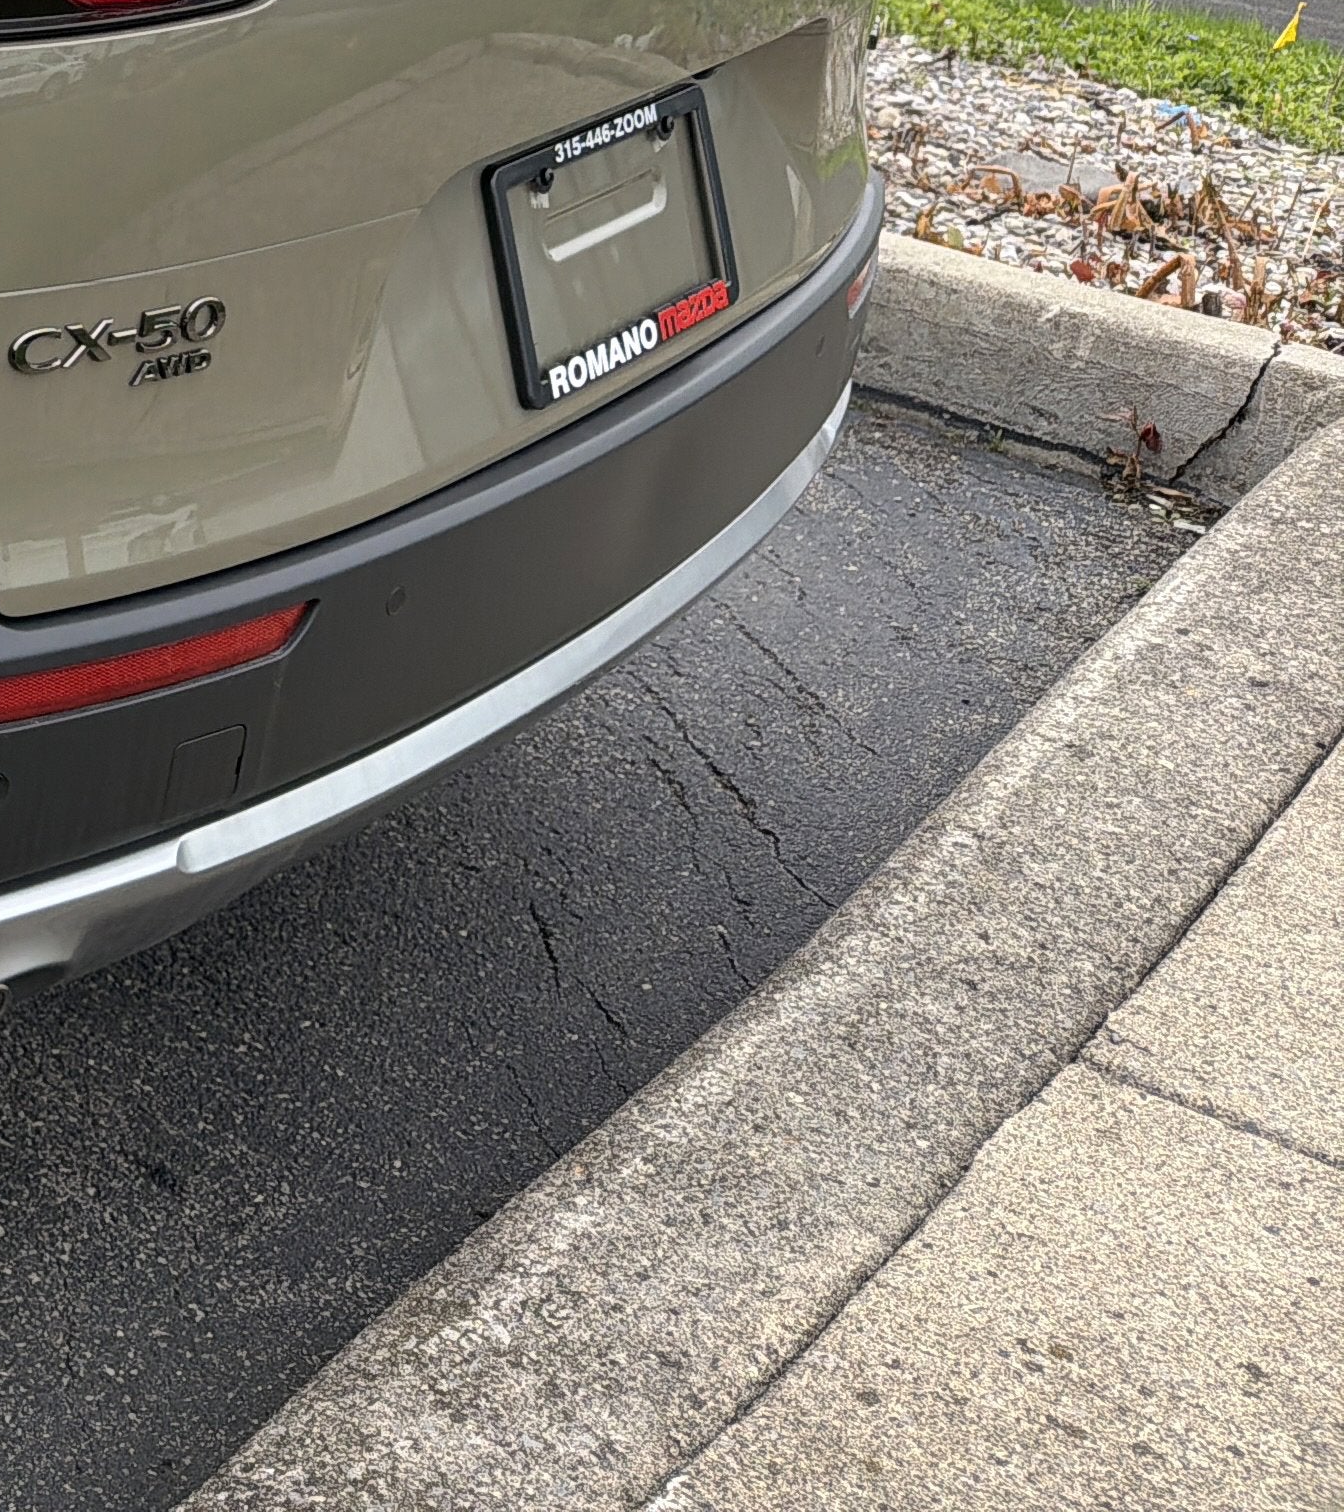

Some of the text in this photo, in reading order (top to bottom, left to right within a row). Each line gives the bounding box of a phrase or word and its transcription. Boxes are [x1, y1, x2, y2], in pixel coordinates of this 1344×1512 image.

[554, 103, 658, 164] 315-446-ZOOM
[7, 294, 227, 375] CX-50
[128, 347, 212, 387] AWD
[549, 318, 658, 399] ROMANO
